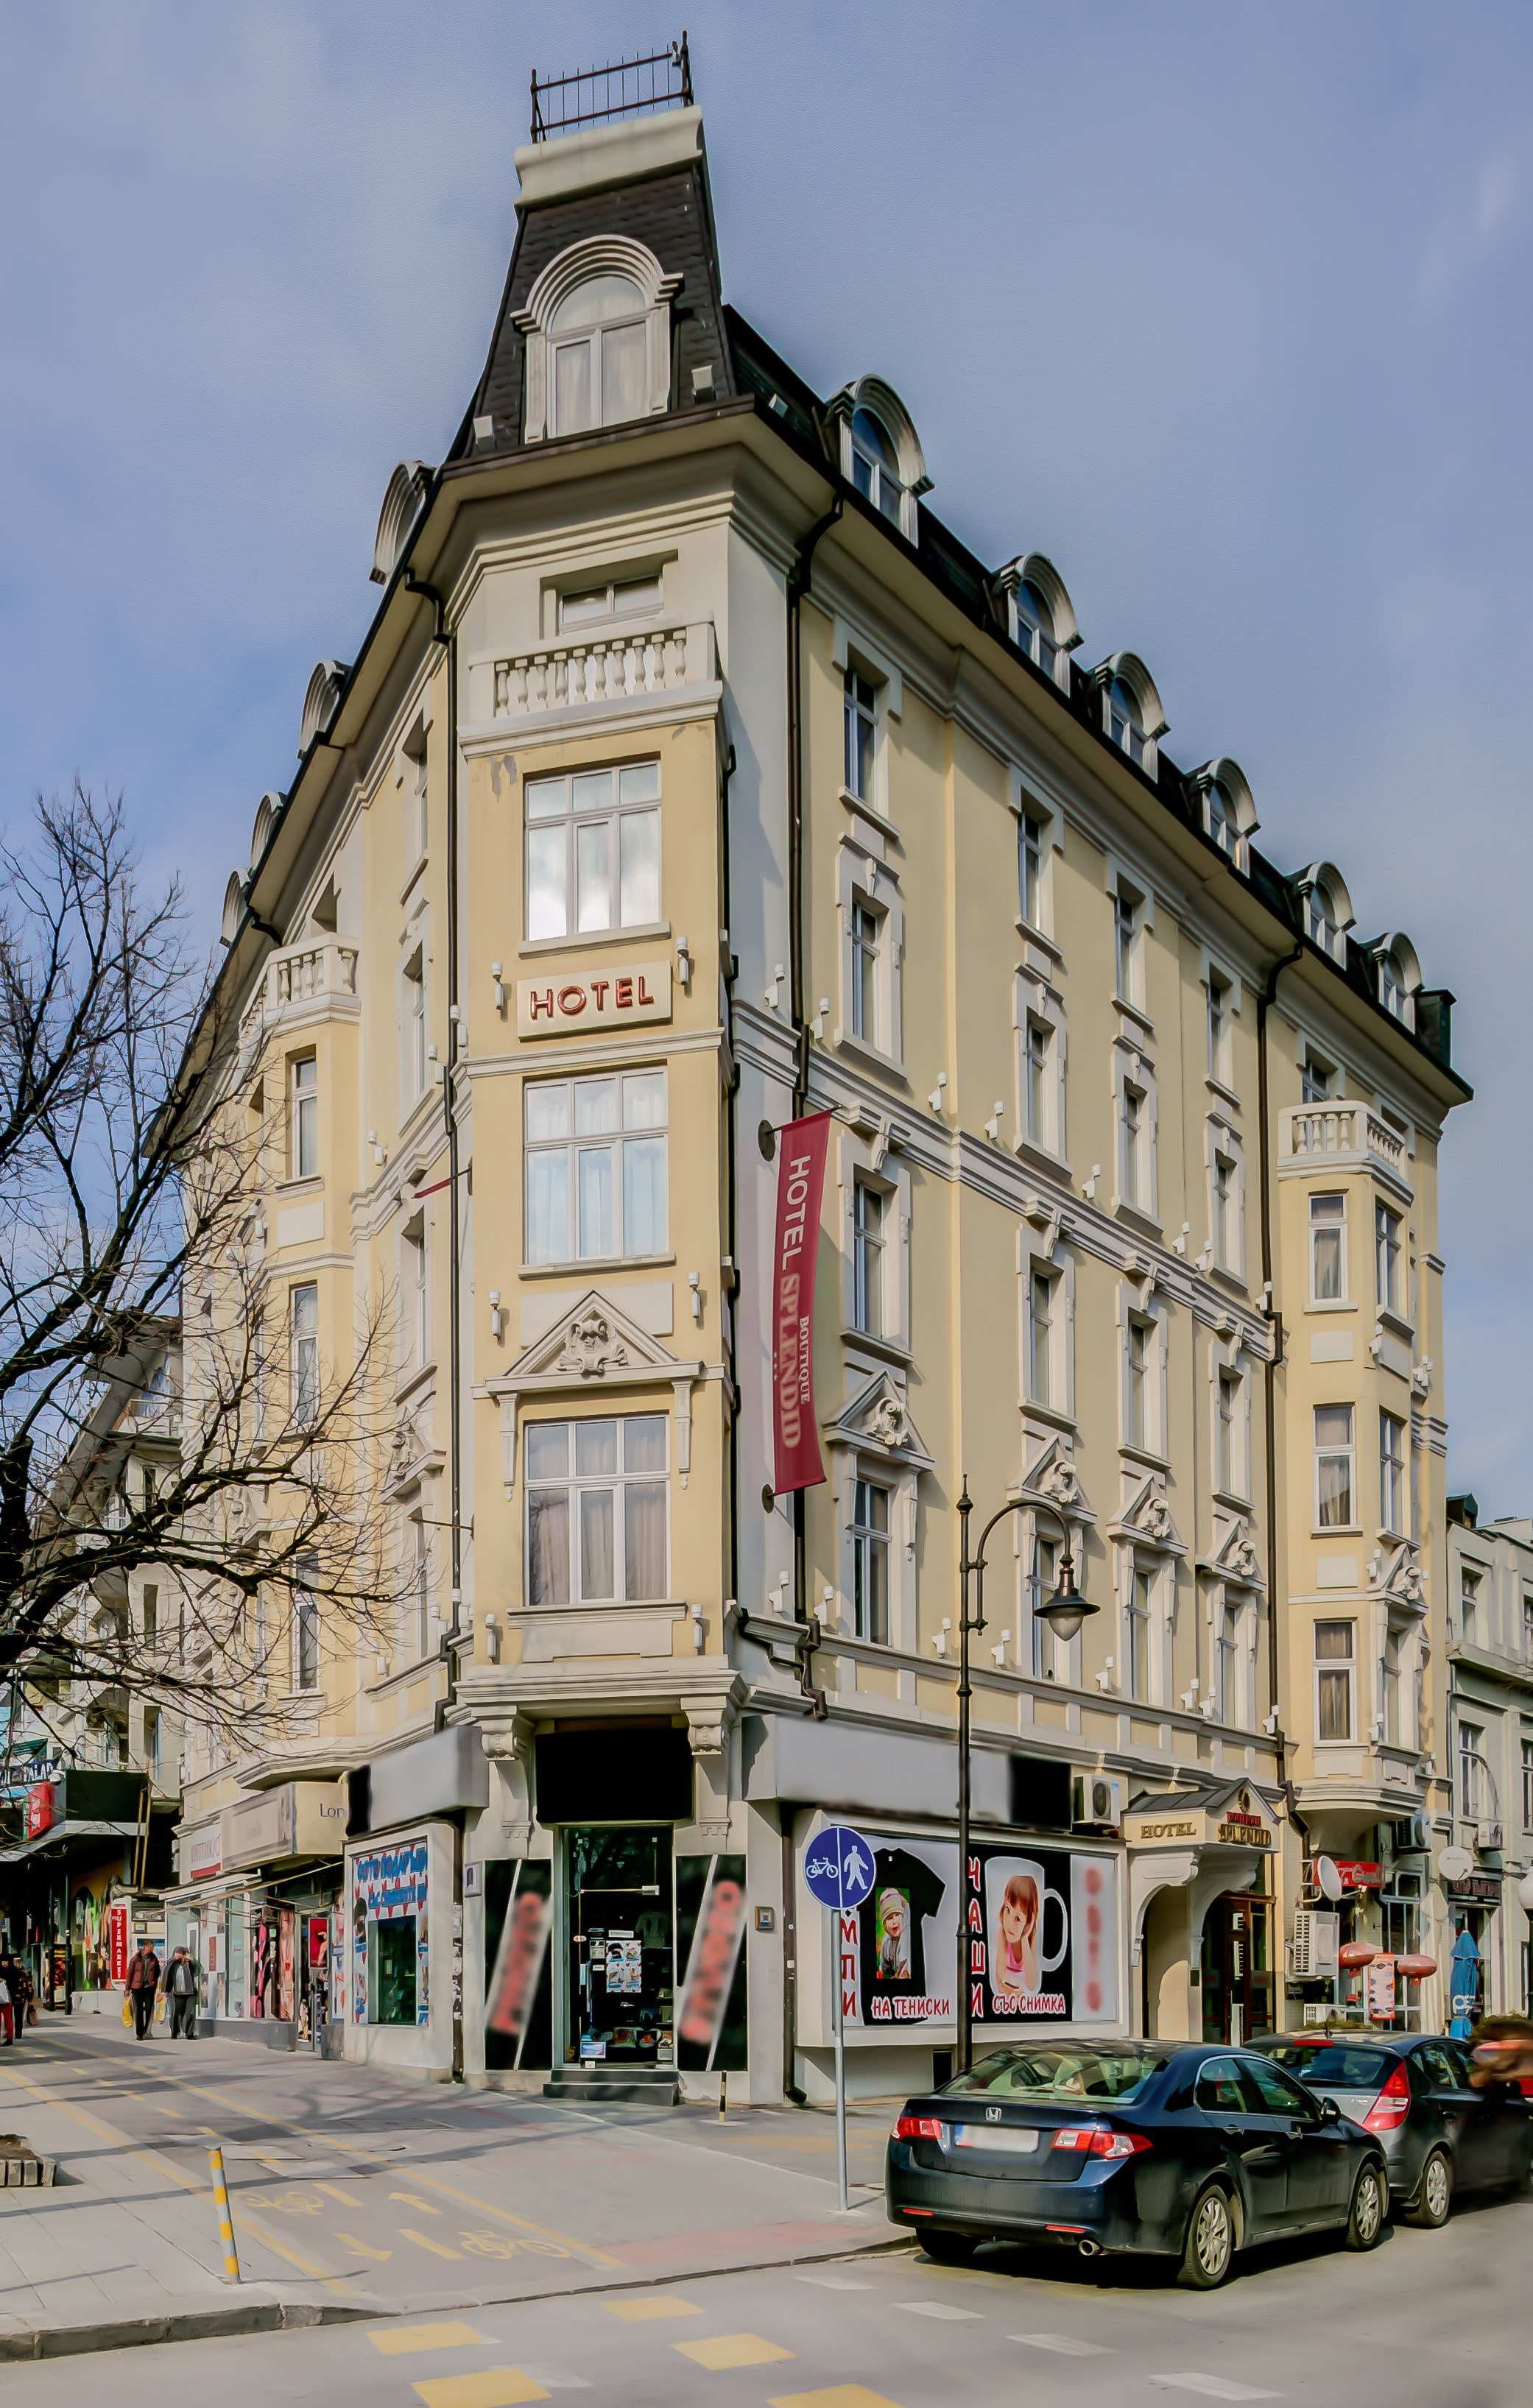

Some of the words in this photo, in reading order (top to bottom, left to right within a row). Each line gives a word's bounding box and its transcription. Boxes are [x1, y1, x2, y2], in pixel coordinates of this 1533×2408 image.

[530, 976, 654, 1020] HOTEL
[783, 1155, 811, 1271] HOTEL
[779, 1273, 801, 1449] SPLENDID
[798, 1316, 810, 1405] BOUTIQUE
[1141, 1822, 1197, 1839] HOTEL
[968, 1857, 985, 2018] ЧАШИ
[873, 1997, 891, 2017] НА
[893, 1997, 951, 2016] ТЕНИСКИ
[993, 1994, 1017, 2013] СЪС
[1019, 1994, 1066, 2013] СНИМКА
